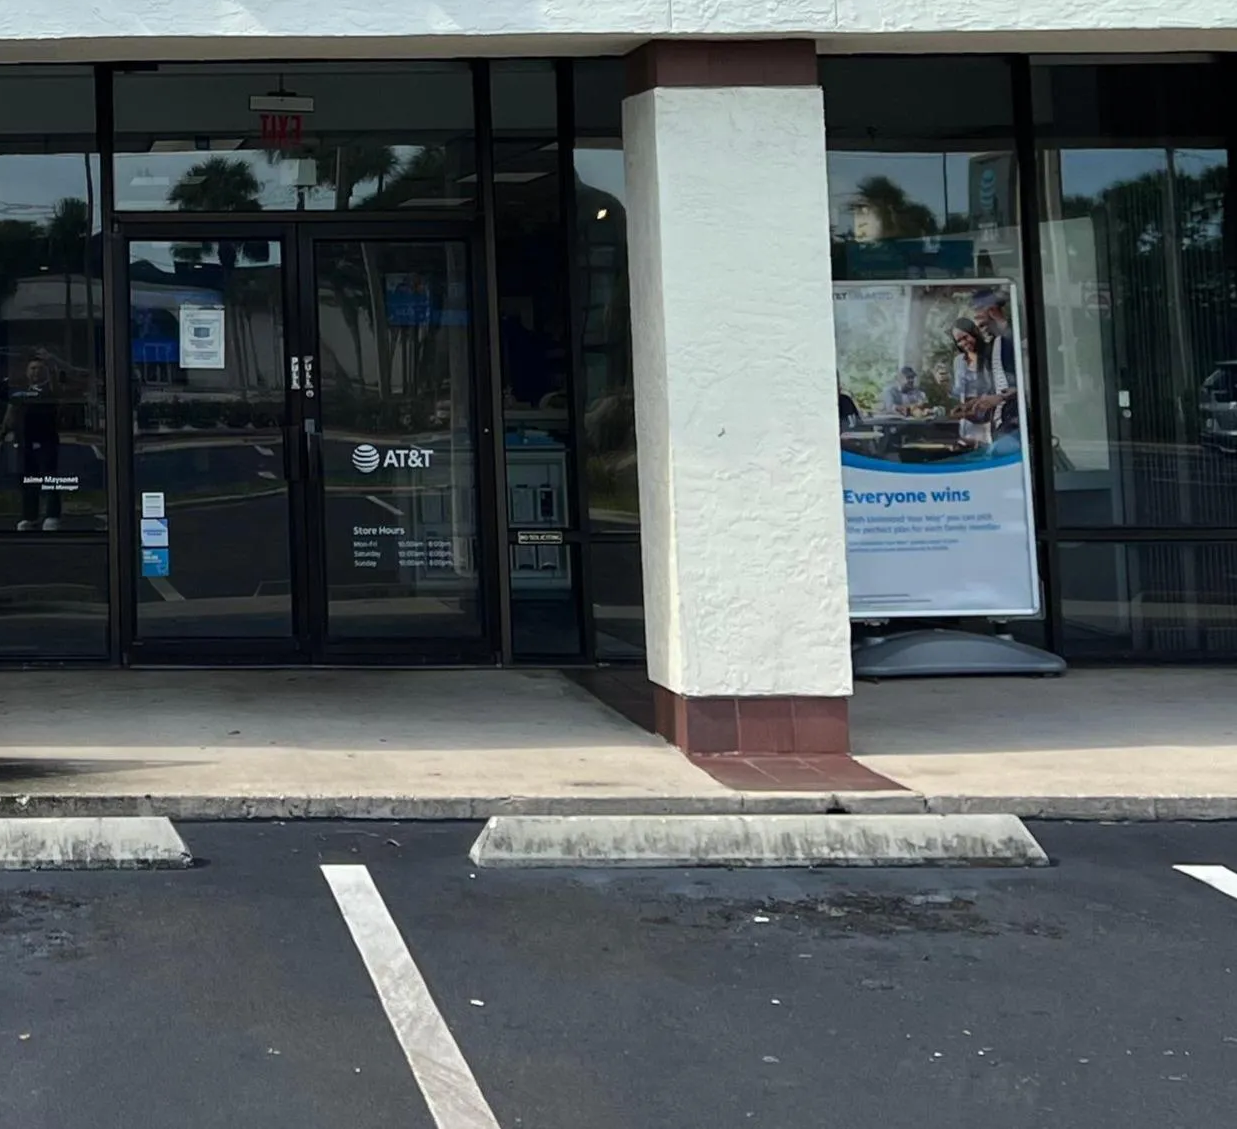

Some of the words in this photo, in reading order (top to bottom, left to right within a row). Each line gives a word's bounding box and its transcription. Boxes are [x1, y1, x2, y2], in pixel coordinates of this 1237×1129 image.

[383, 449, 434, 468] AT&T
[843, 489, 927, 508] Everyone
[930, 486, 970, 502] wins
[353, 526, 378, 536] Store
[378, 526, 405, 535] Hours
[354, 550, 381, 559] Saturday
[354, 560, 377, 568] Sunday
